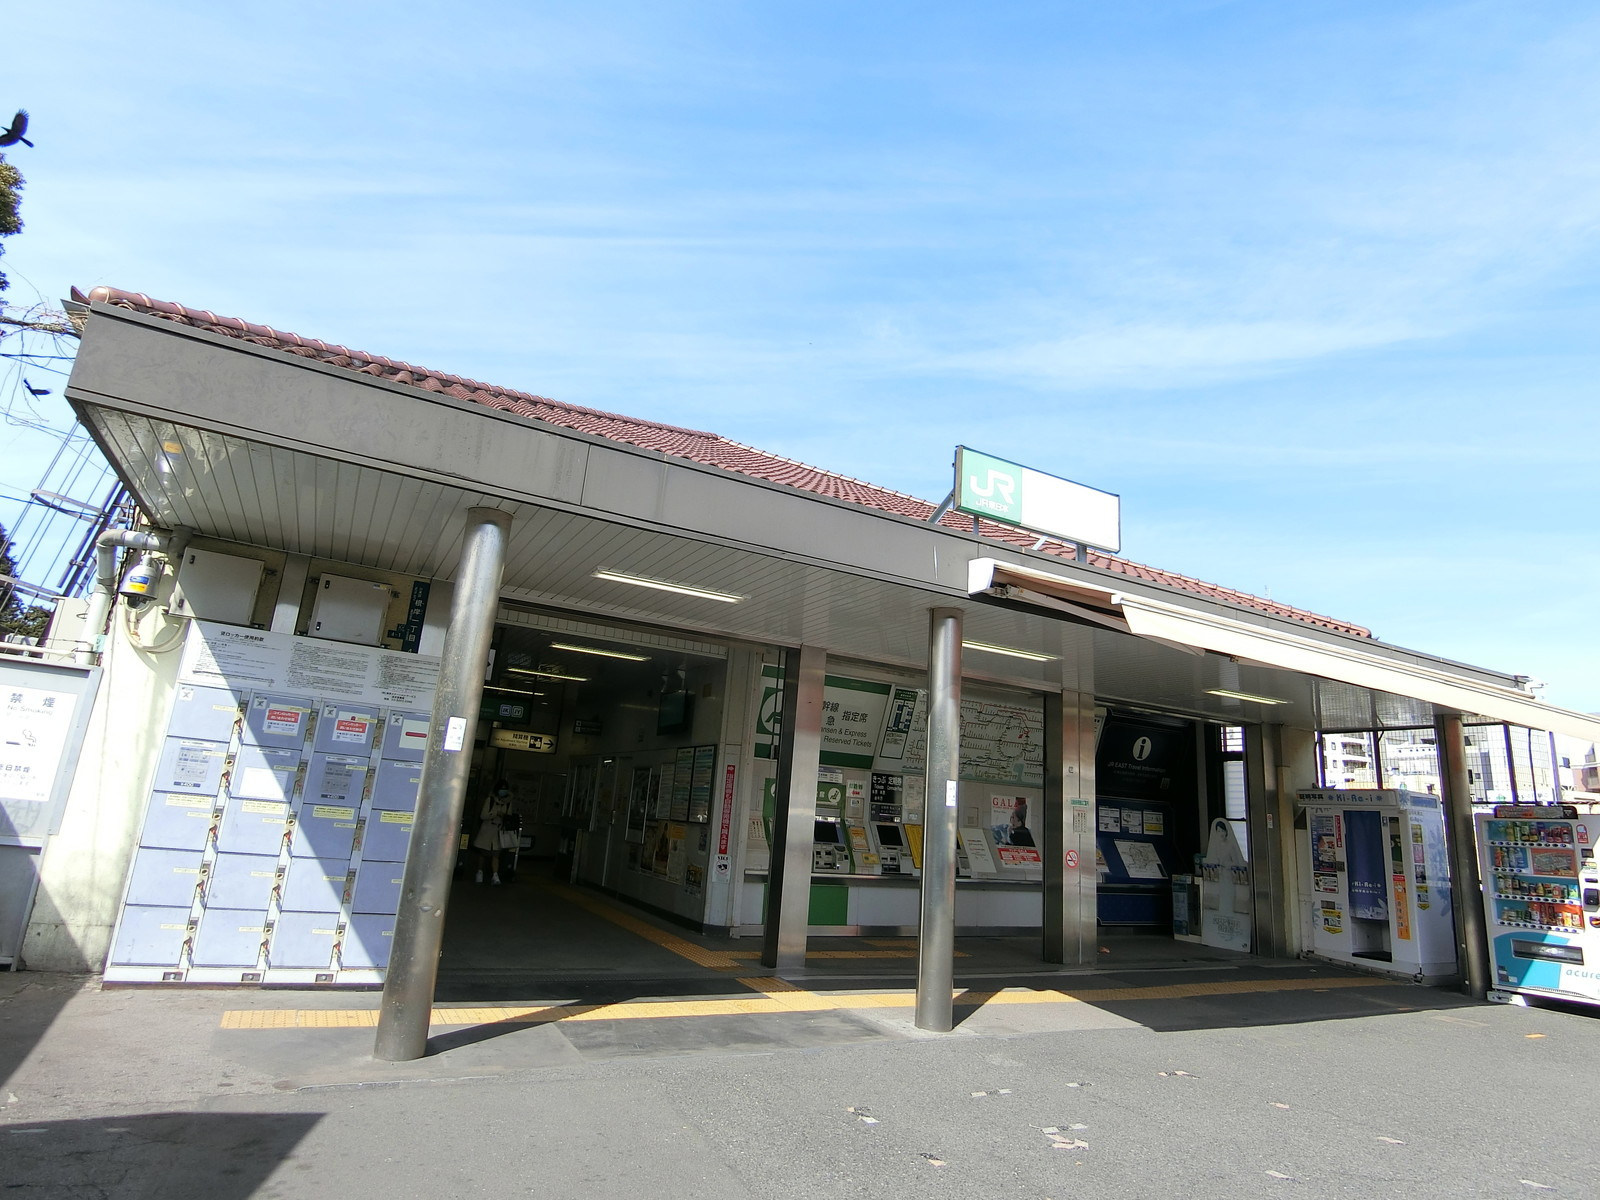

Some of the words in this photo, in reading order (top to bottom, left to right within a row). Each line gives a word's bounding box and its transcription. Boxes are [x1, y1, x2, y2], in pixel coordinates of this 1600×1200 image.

[969, 468, 1016, 505] JR
[408, 599, 425, 643] 根岸一丁目
[6, 703, 18, 712] No
[20, 705, 54, 717] Smoking
[841, 711, 869, 724] 指定席
[844, 729, 868, 739] Express
[823, 735, 852, 746] Reserved
[852, 739, 873, 749] Tickets
[872, 775, 887, 784] きっぷ
